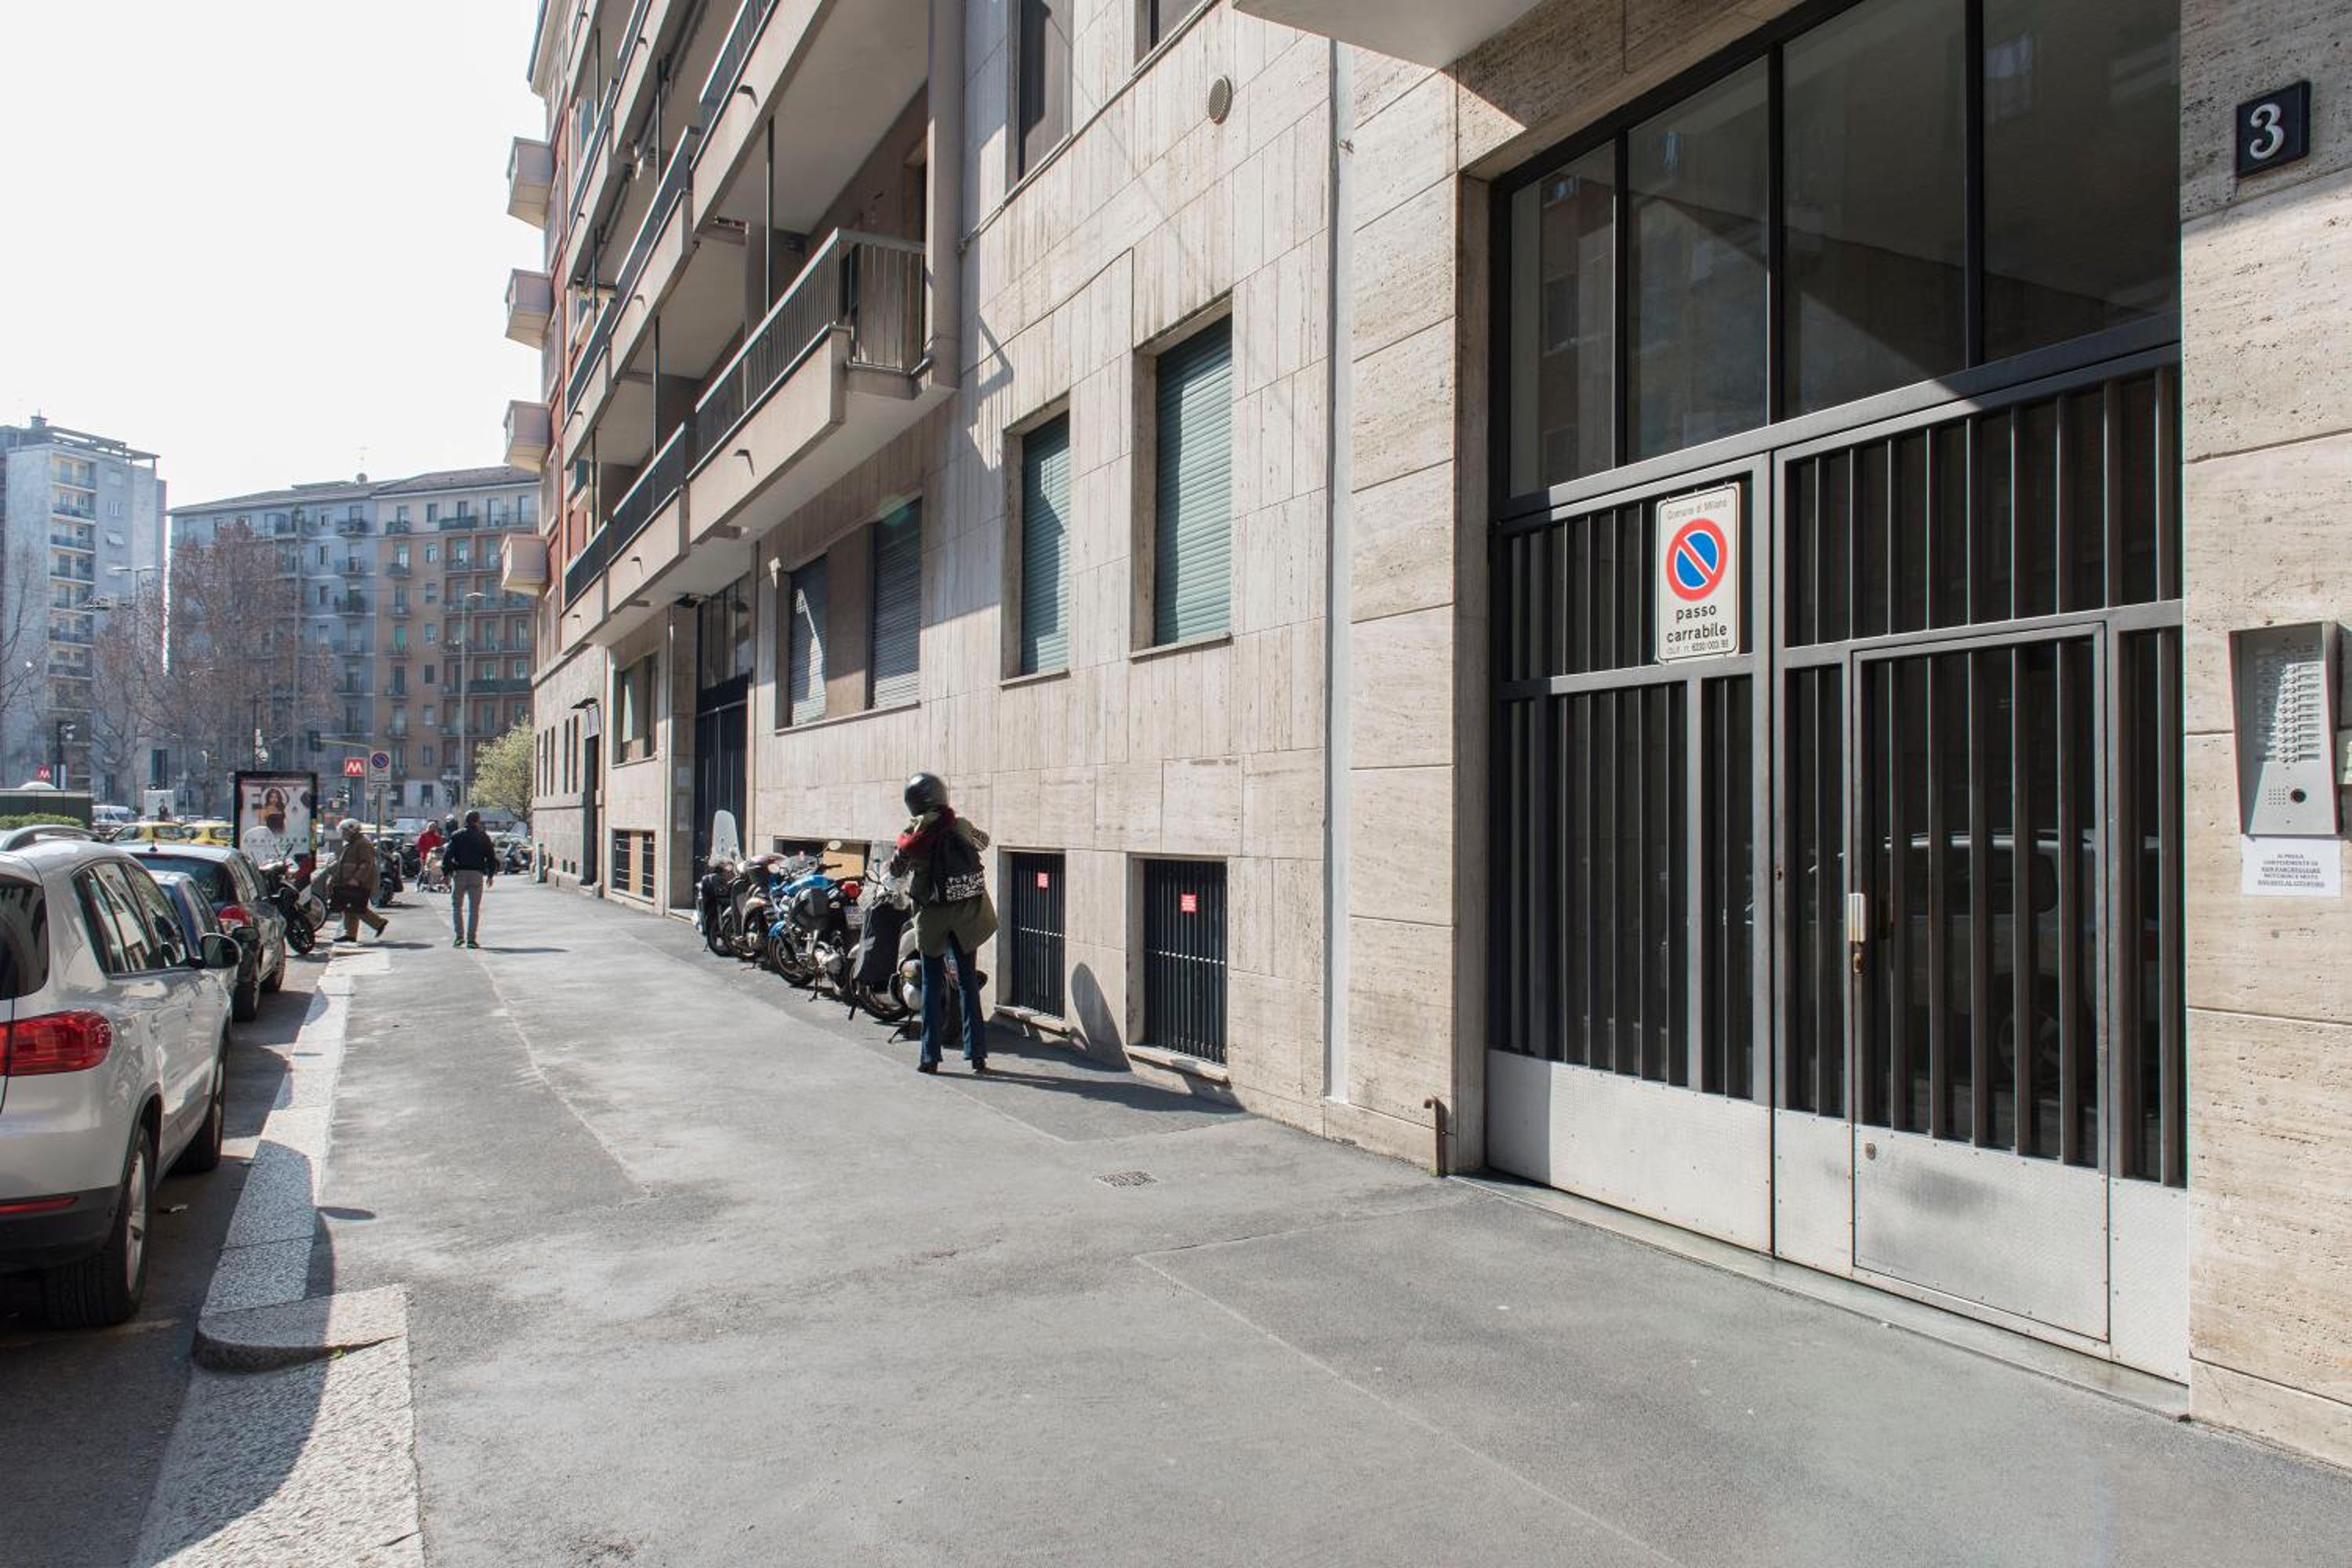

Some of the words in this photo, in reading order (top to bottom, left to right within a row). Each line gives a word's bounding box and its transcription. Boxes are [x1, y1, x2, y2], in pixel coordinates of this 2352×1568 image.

[2249, 102, 2285, 160] 3
[1675, 604, 1717, 624] passo
[1666, 623, 1728, 644] carrabile
[347, 761, 364, 774] M
